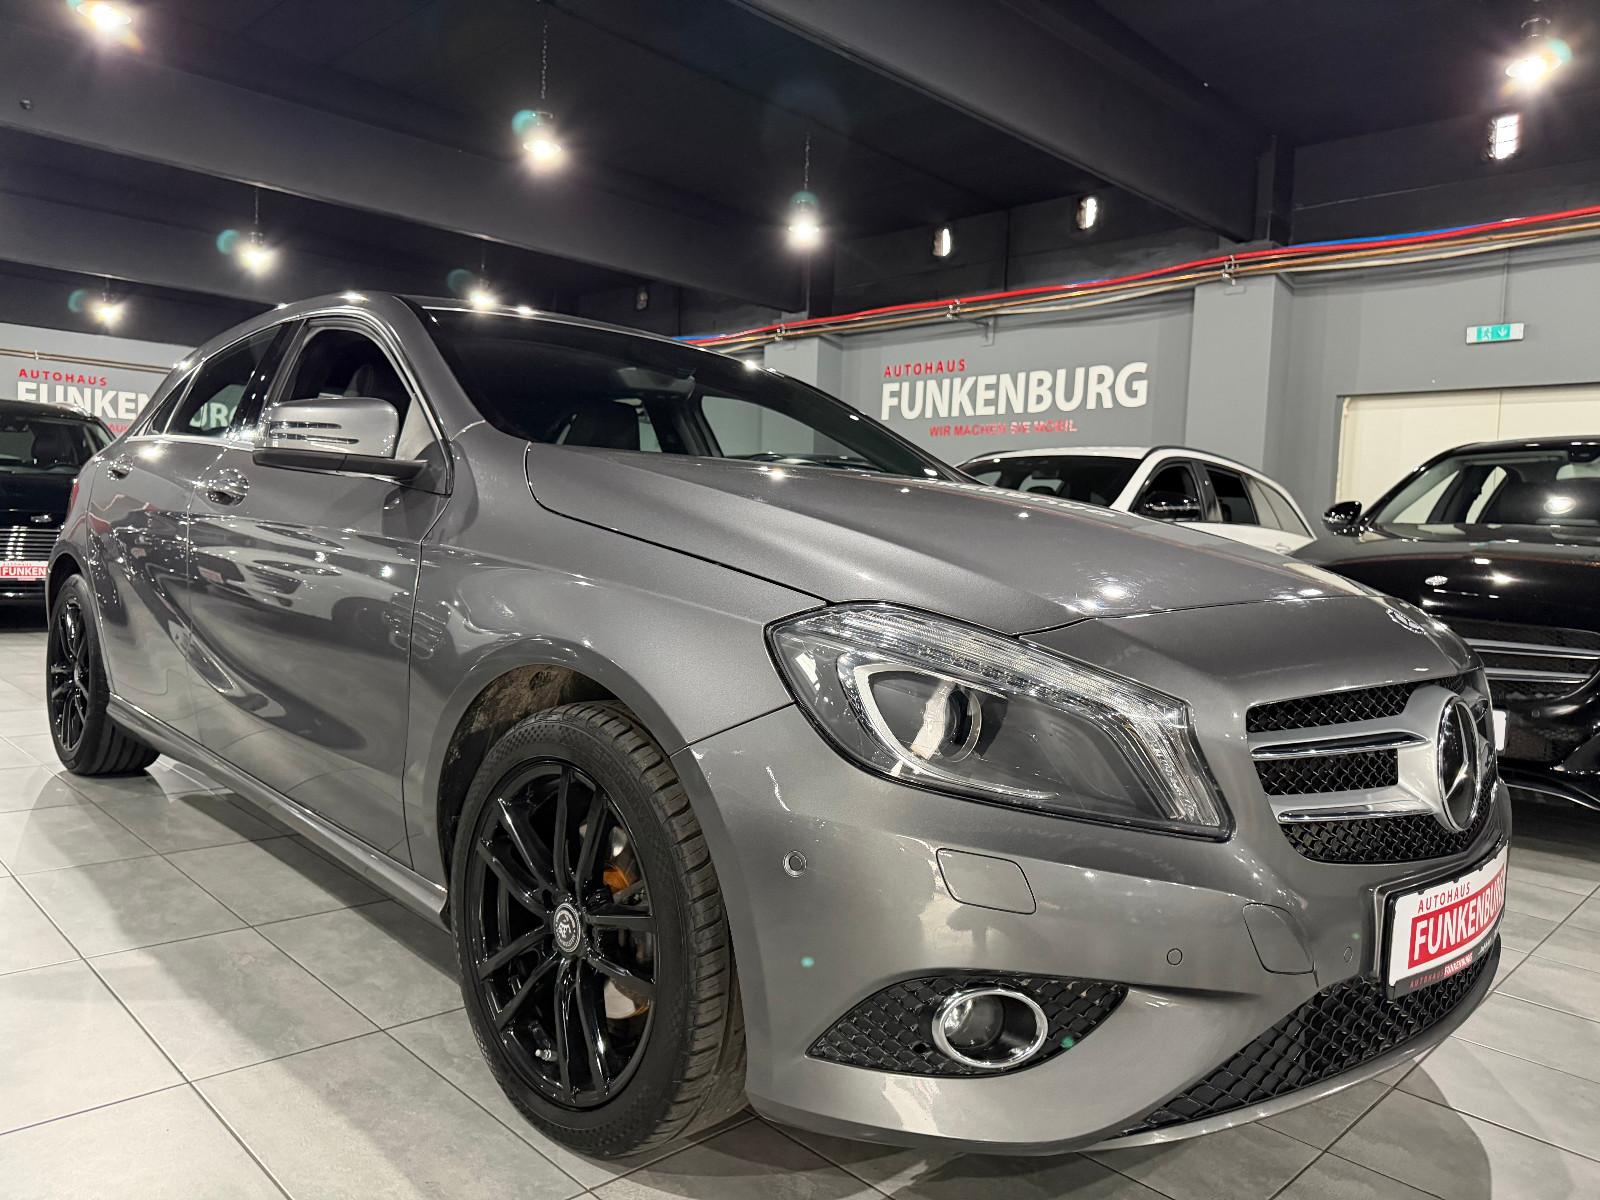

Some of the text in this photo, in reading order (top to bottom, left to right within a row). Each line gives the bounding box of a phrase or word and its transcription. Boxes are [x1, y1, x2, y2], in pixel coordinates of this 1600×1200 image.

[18, 368, 108, 387] AUTOHAUS
[883, 358, 967, 378] AUTOHAUS
[880, 361, 1149, 421] FUNKENBURG
[929, 419, 1078, 438] WIR MACHEN SIE MOBIL
[1417, 881, 1471, 914] AUTOHAUS
